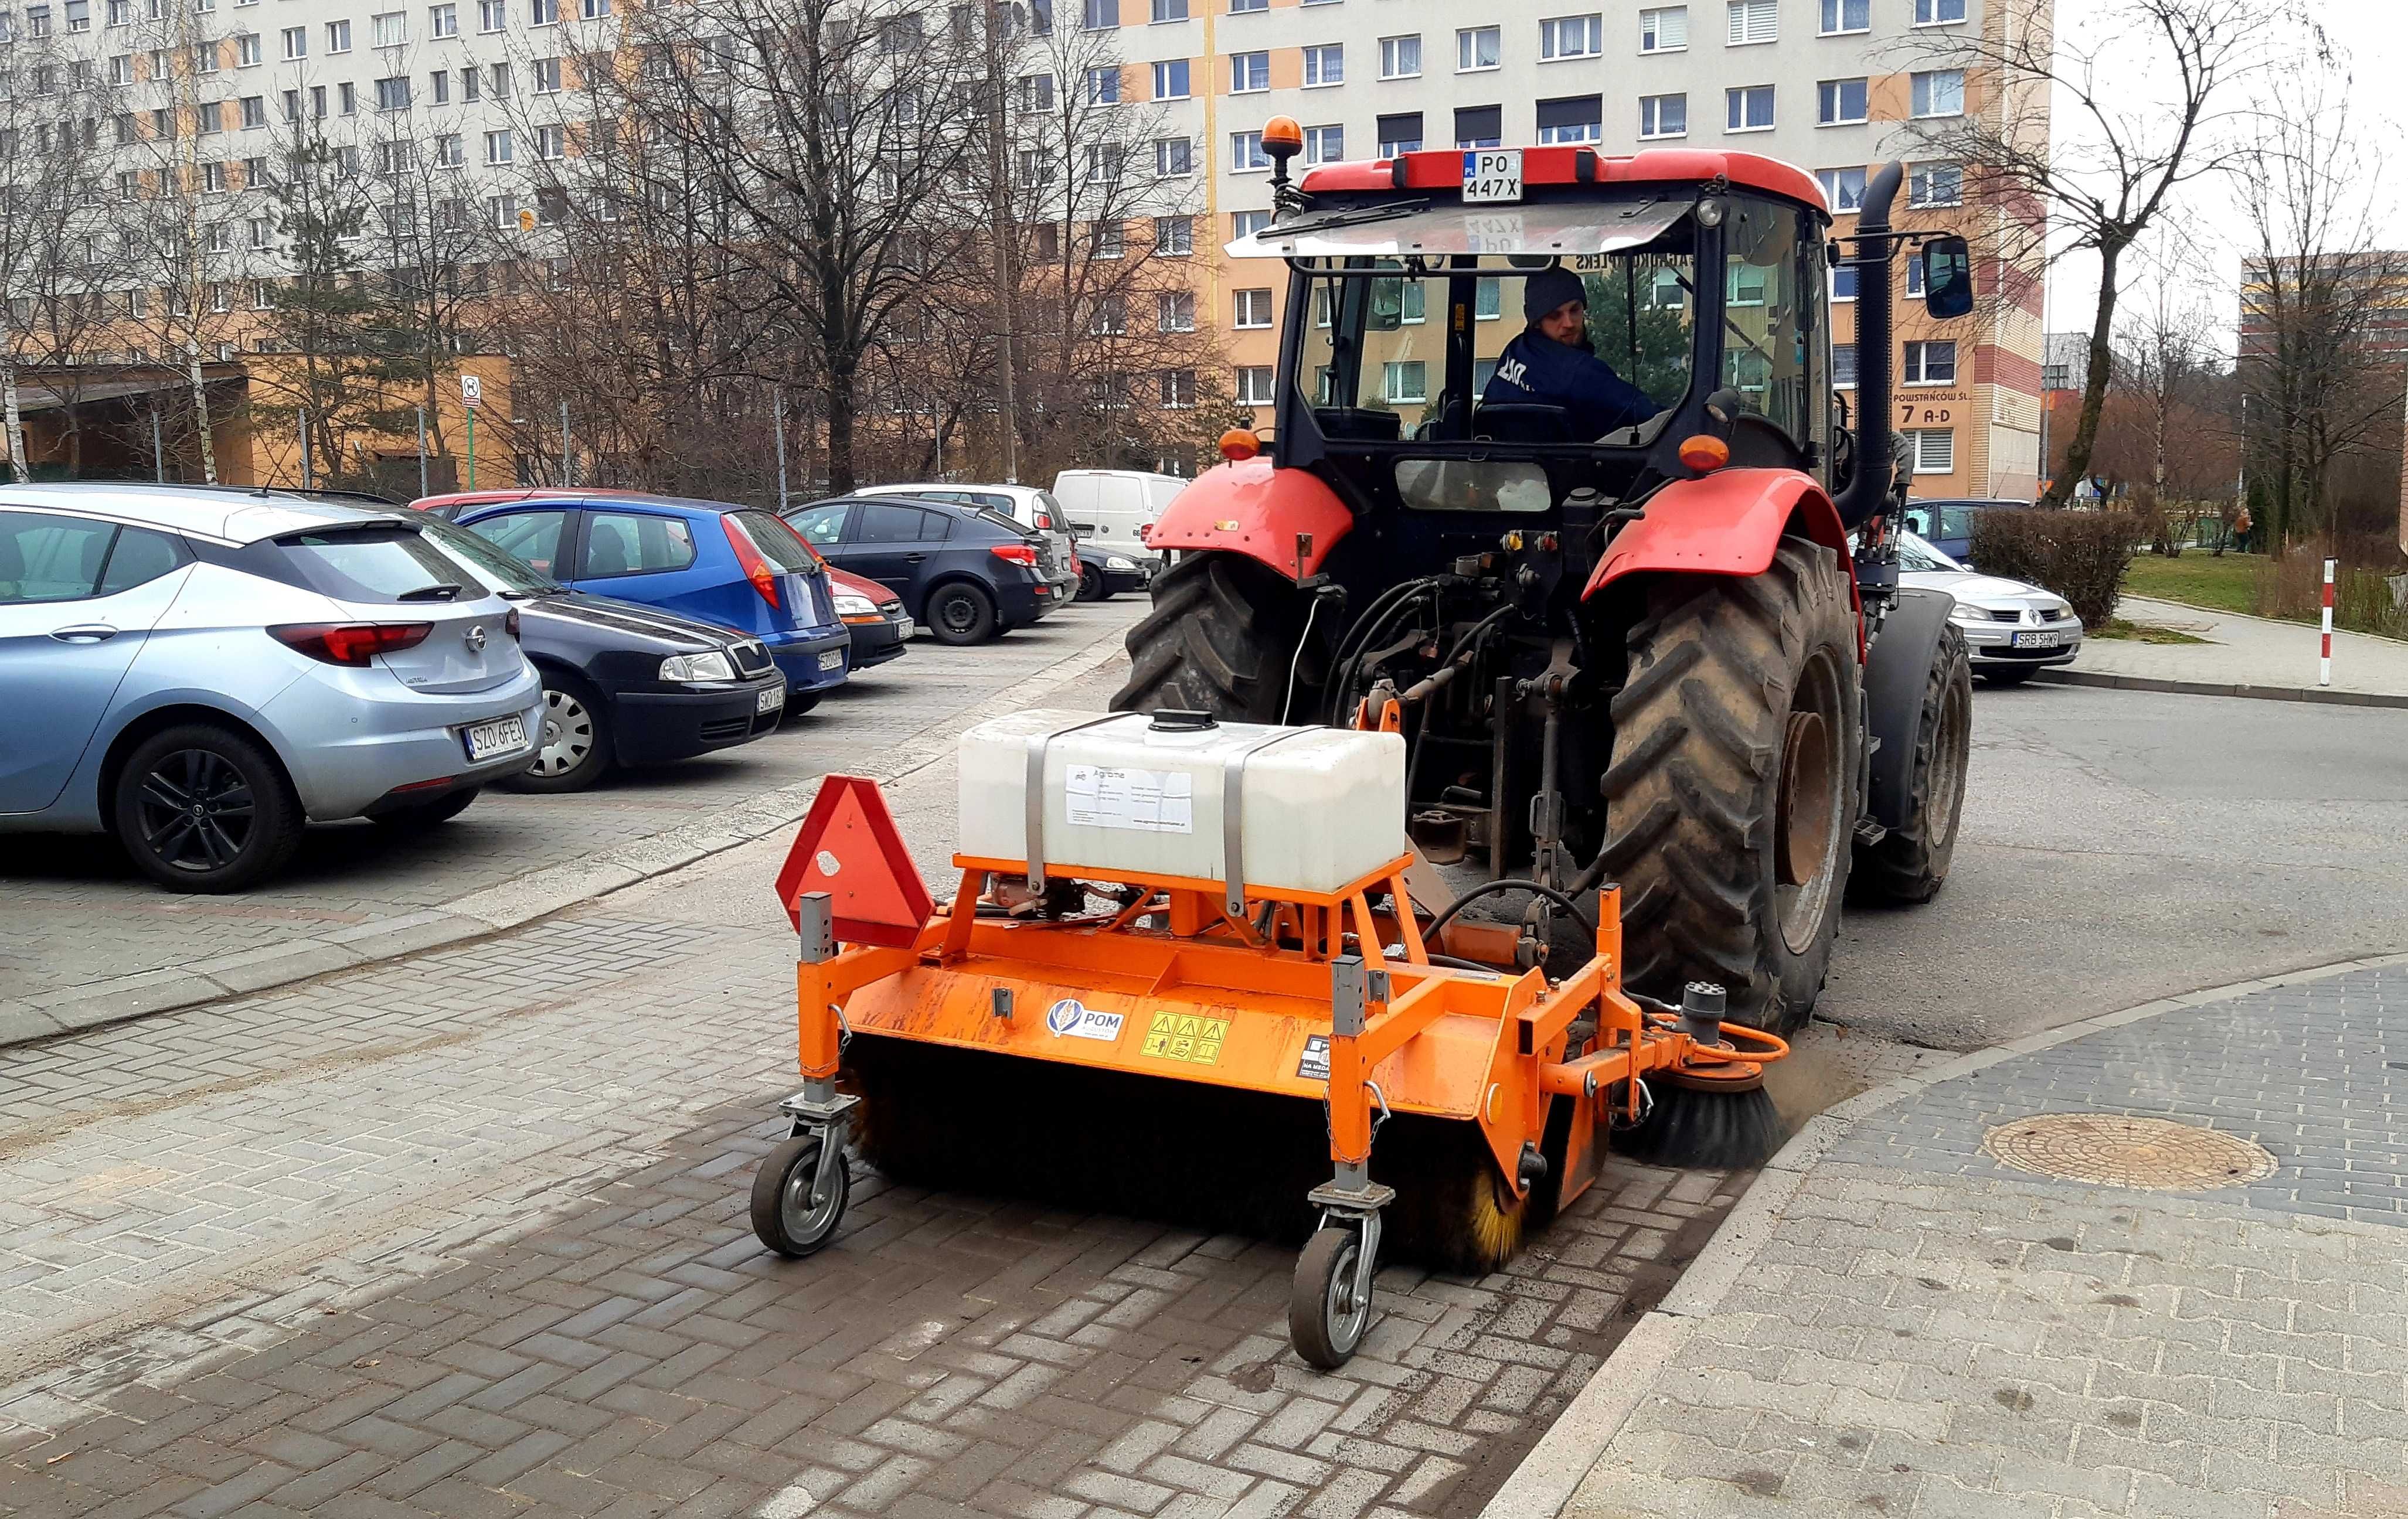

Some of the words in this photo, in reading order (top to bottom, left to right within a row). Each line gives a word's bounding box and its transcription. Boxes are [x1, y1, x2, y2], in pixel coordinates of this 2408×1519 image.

[1482, 156, 1507, 173] PO
[1467, 179, 1518, 197] 447X
[1902, 406, 1914, 423] 7
[1924, 410, 1950, 423] A-D
[2019, 634, 2036, 645] SRB
[2039, 634, 2058, 645] 5HW9
[473, 727, 496, 750] SZO
[498, 720, 522, 744] 6FE3
[1084, 1013, 1120, 1028] POM
